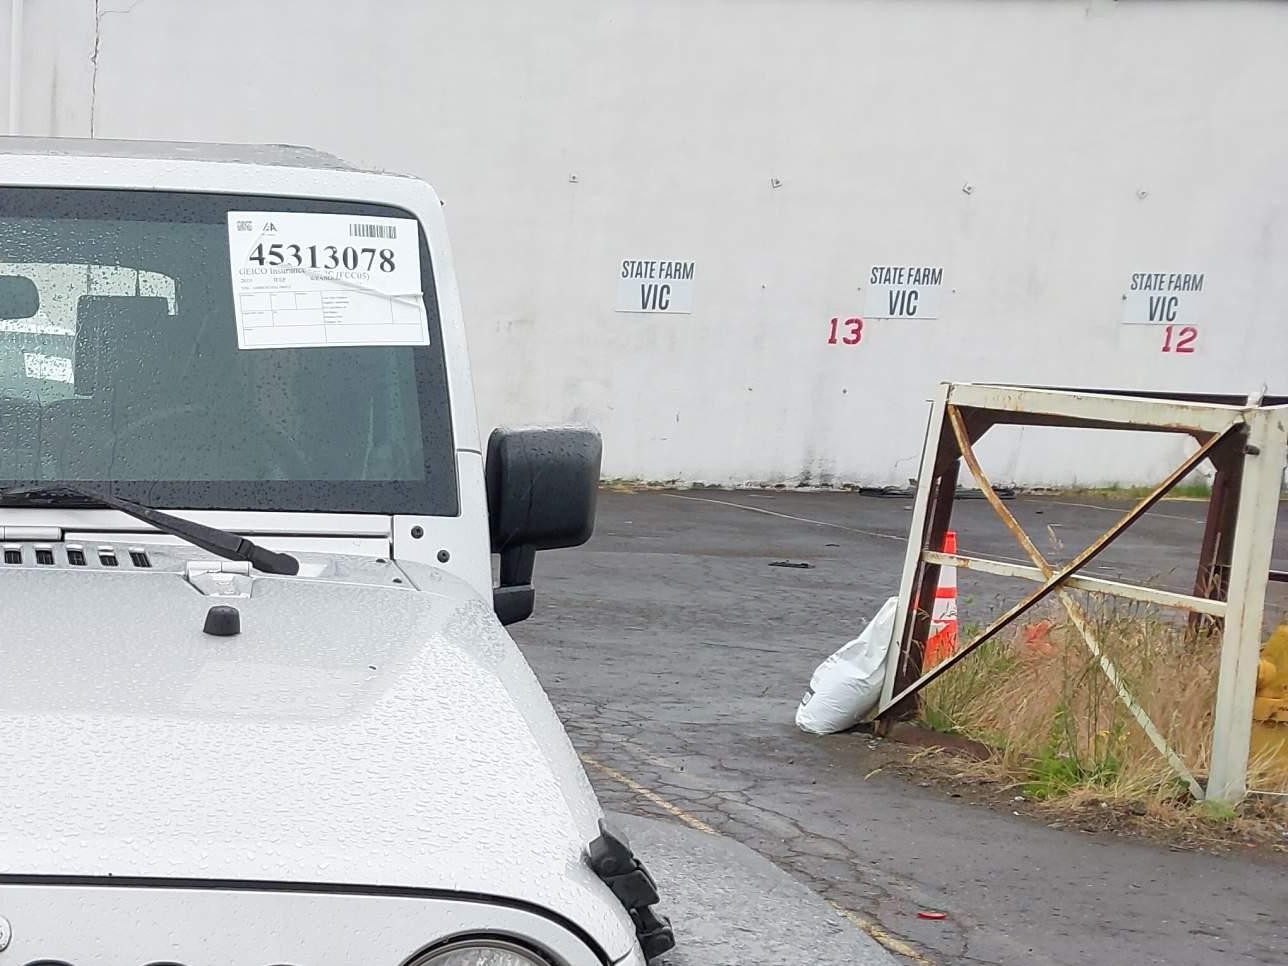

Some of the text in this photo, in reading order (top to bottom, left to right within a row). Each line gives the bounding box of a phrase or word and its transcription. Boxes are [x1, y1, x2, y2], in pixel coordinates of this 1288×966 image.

[248, 243, 396, 272] 45313078
[621, 260, 695, 280] STATE FARM
[870, 266, 943, 286] STATE FARM
[1130, 273, 1205, 292] STATE FARM
[640, 283, 671, 311] VIC
[888, 289, 919, 317] VIC
[1148, 296, 1179, 323] VIC
[827, 317, 864, 345] 13
[1161, 325, 1198, 353] 12
